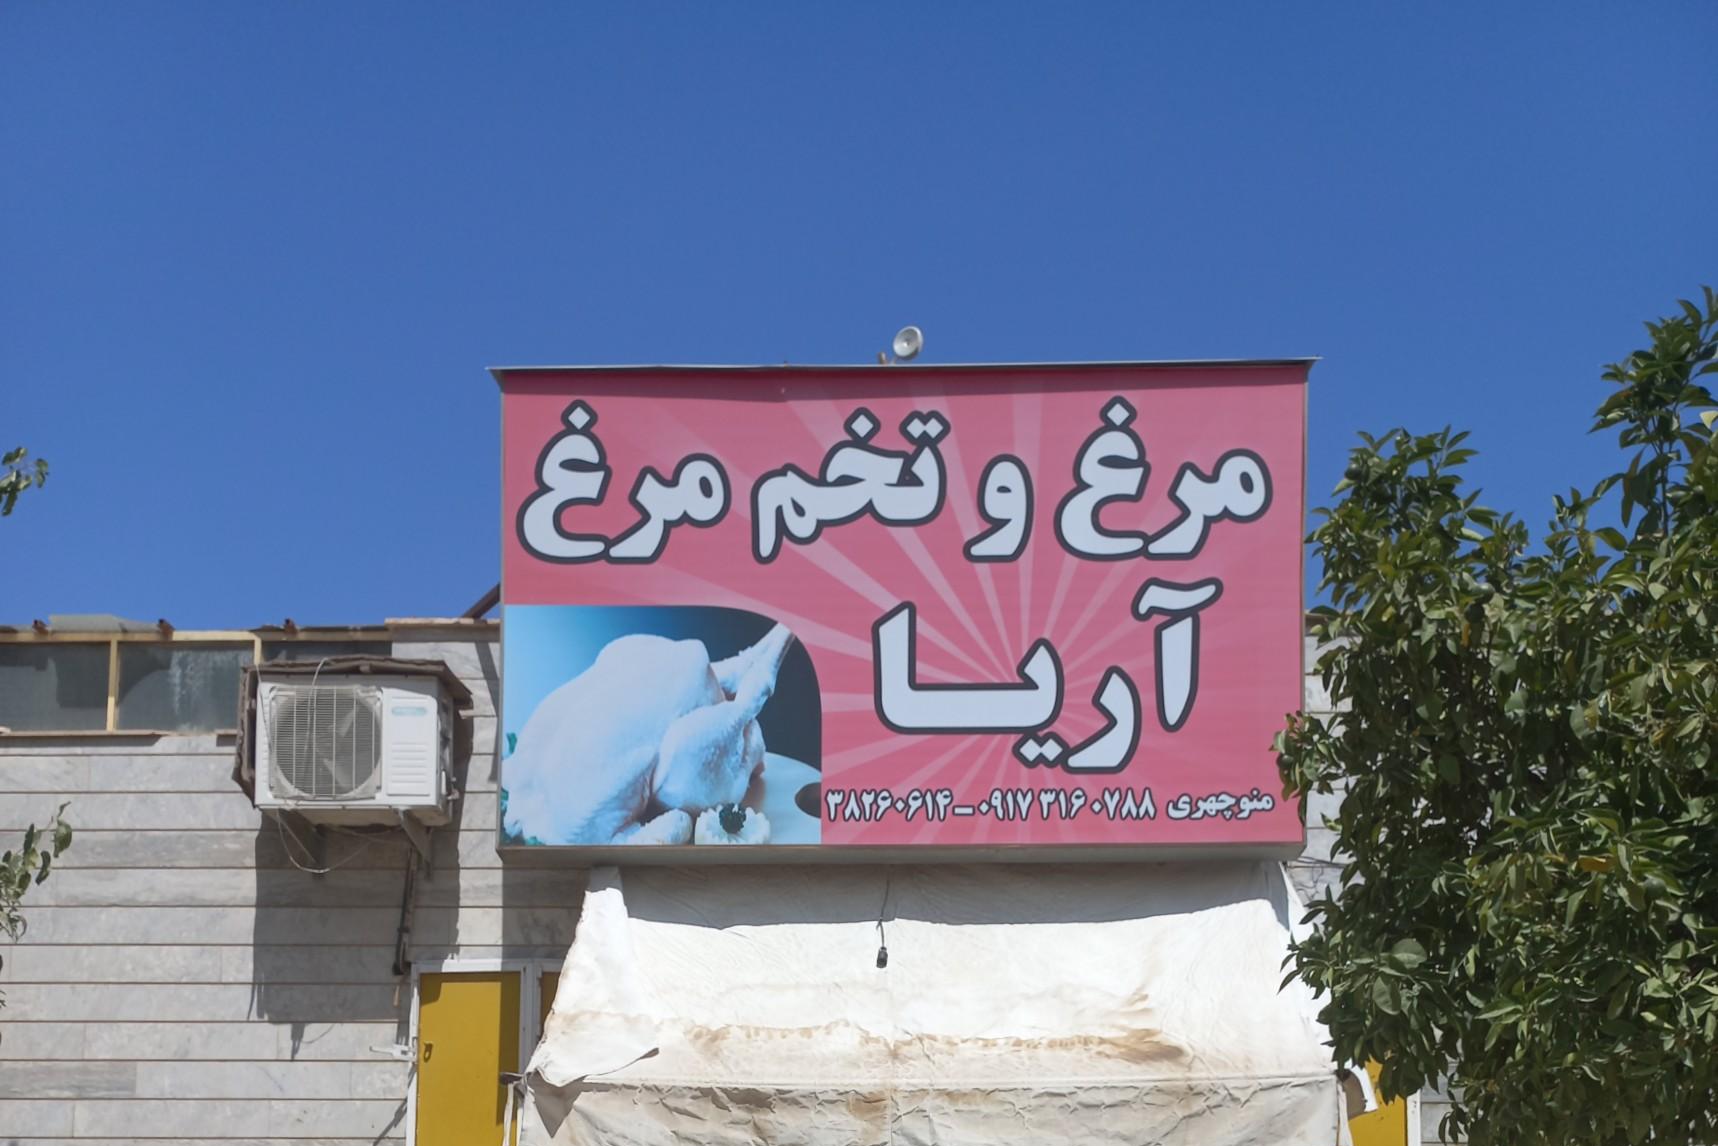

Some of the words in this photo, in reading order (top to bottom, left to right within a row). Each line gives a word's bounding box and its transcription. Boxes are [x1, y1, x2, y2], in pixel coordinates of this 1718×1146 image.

[516, 399, 732, 563] مرغ
[751, 407, 952, 563] تخم
[963, 454, 1034, 562] و
[1054, 396, 1273, 561] مرغ
[872, 576, 1224, 774] آریا
[1167, 787, 1275, 820] منوچهری
